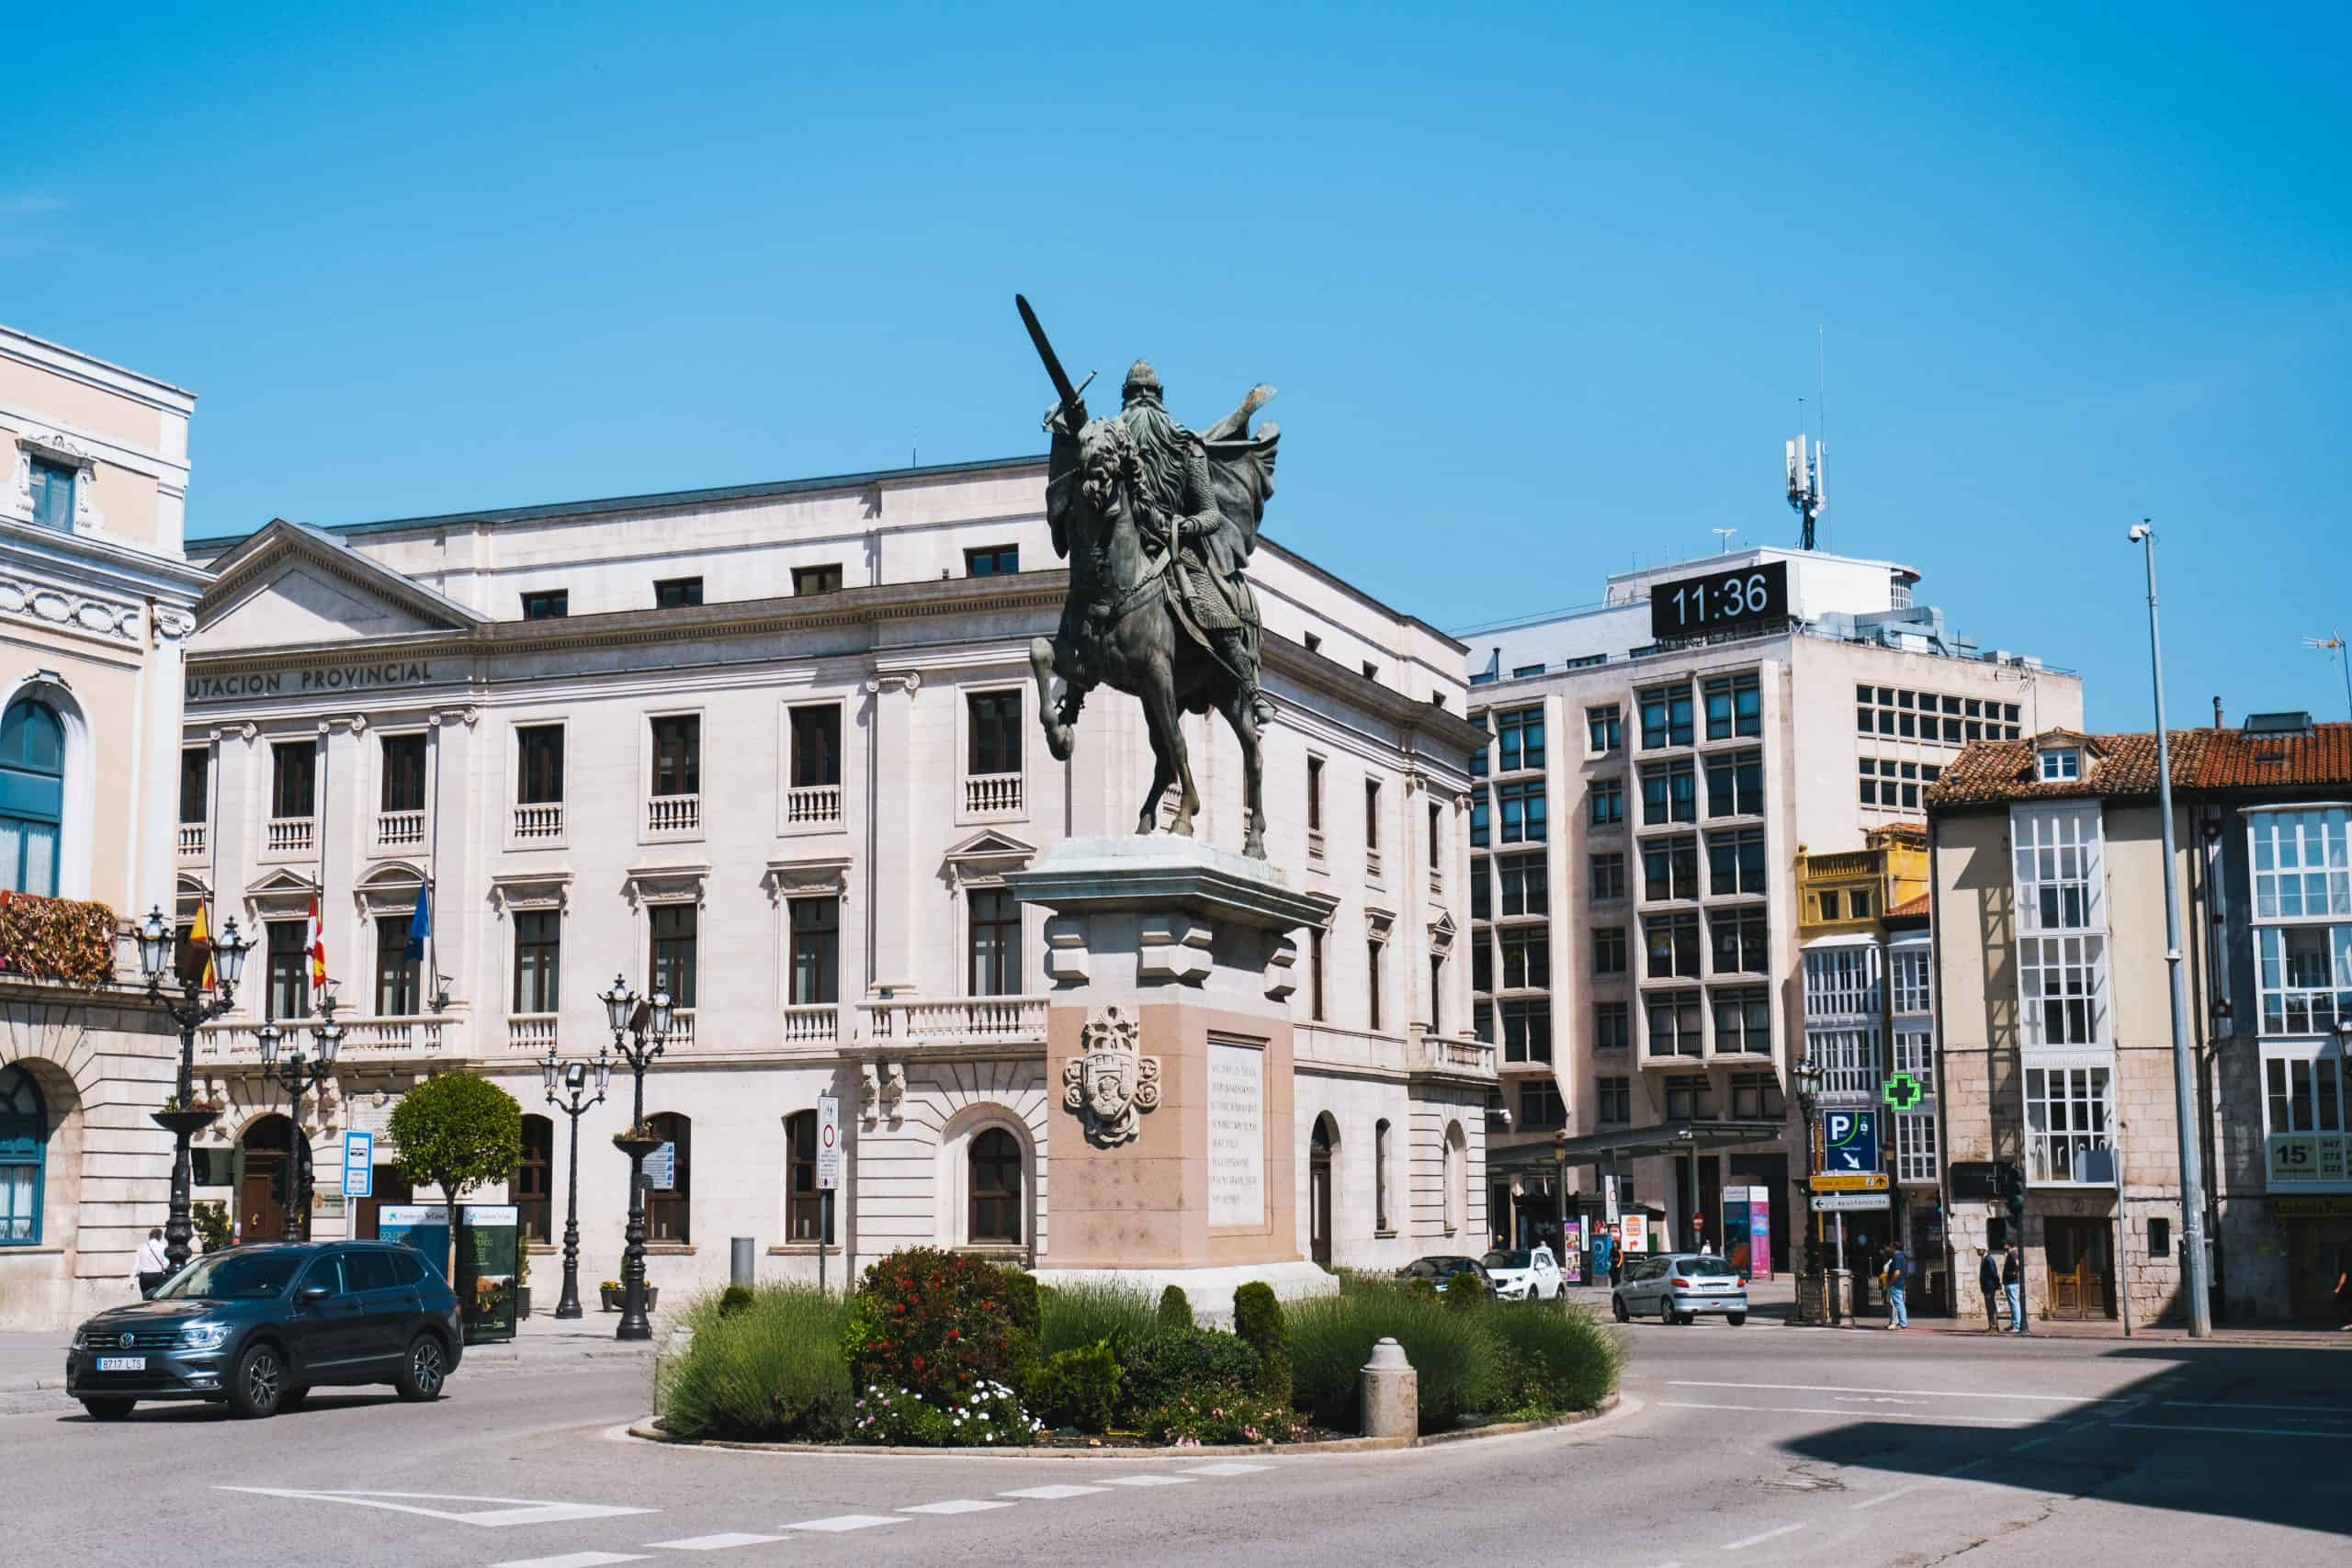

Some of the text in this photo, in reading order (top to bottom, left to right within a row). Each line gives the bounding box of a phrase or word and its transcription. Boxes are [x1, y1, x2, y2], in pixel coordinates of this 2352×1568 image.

[1672, 573, 1767, 626] 11:36
[301, 660, 433, 689] PROVINCIAL
[1831, 1116, 1850, 1141] P
